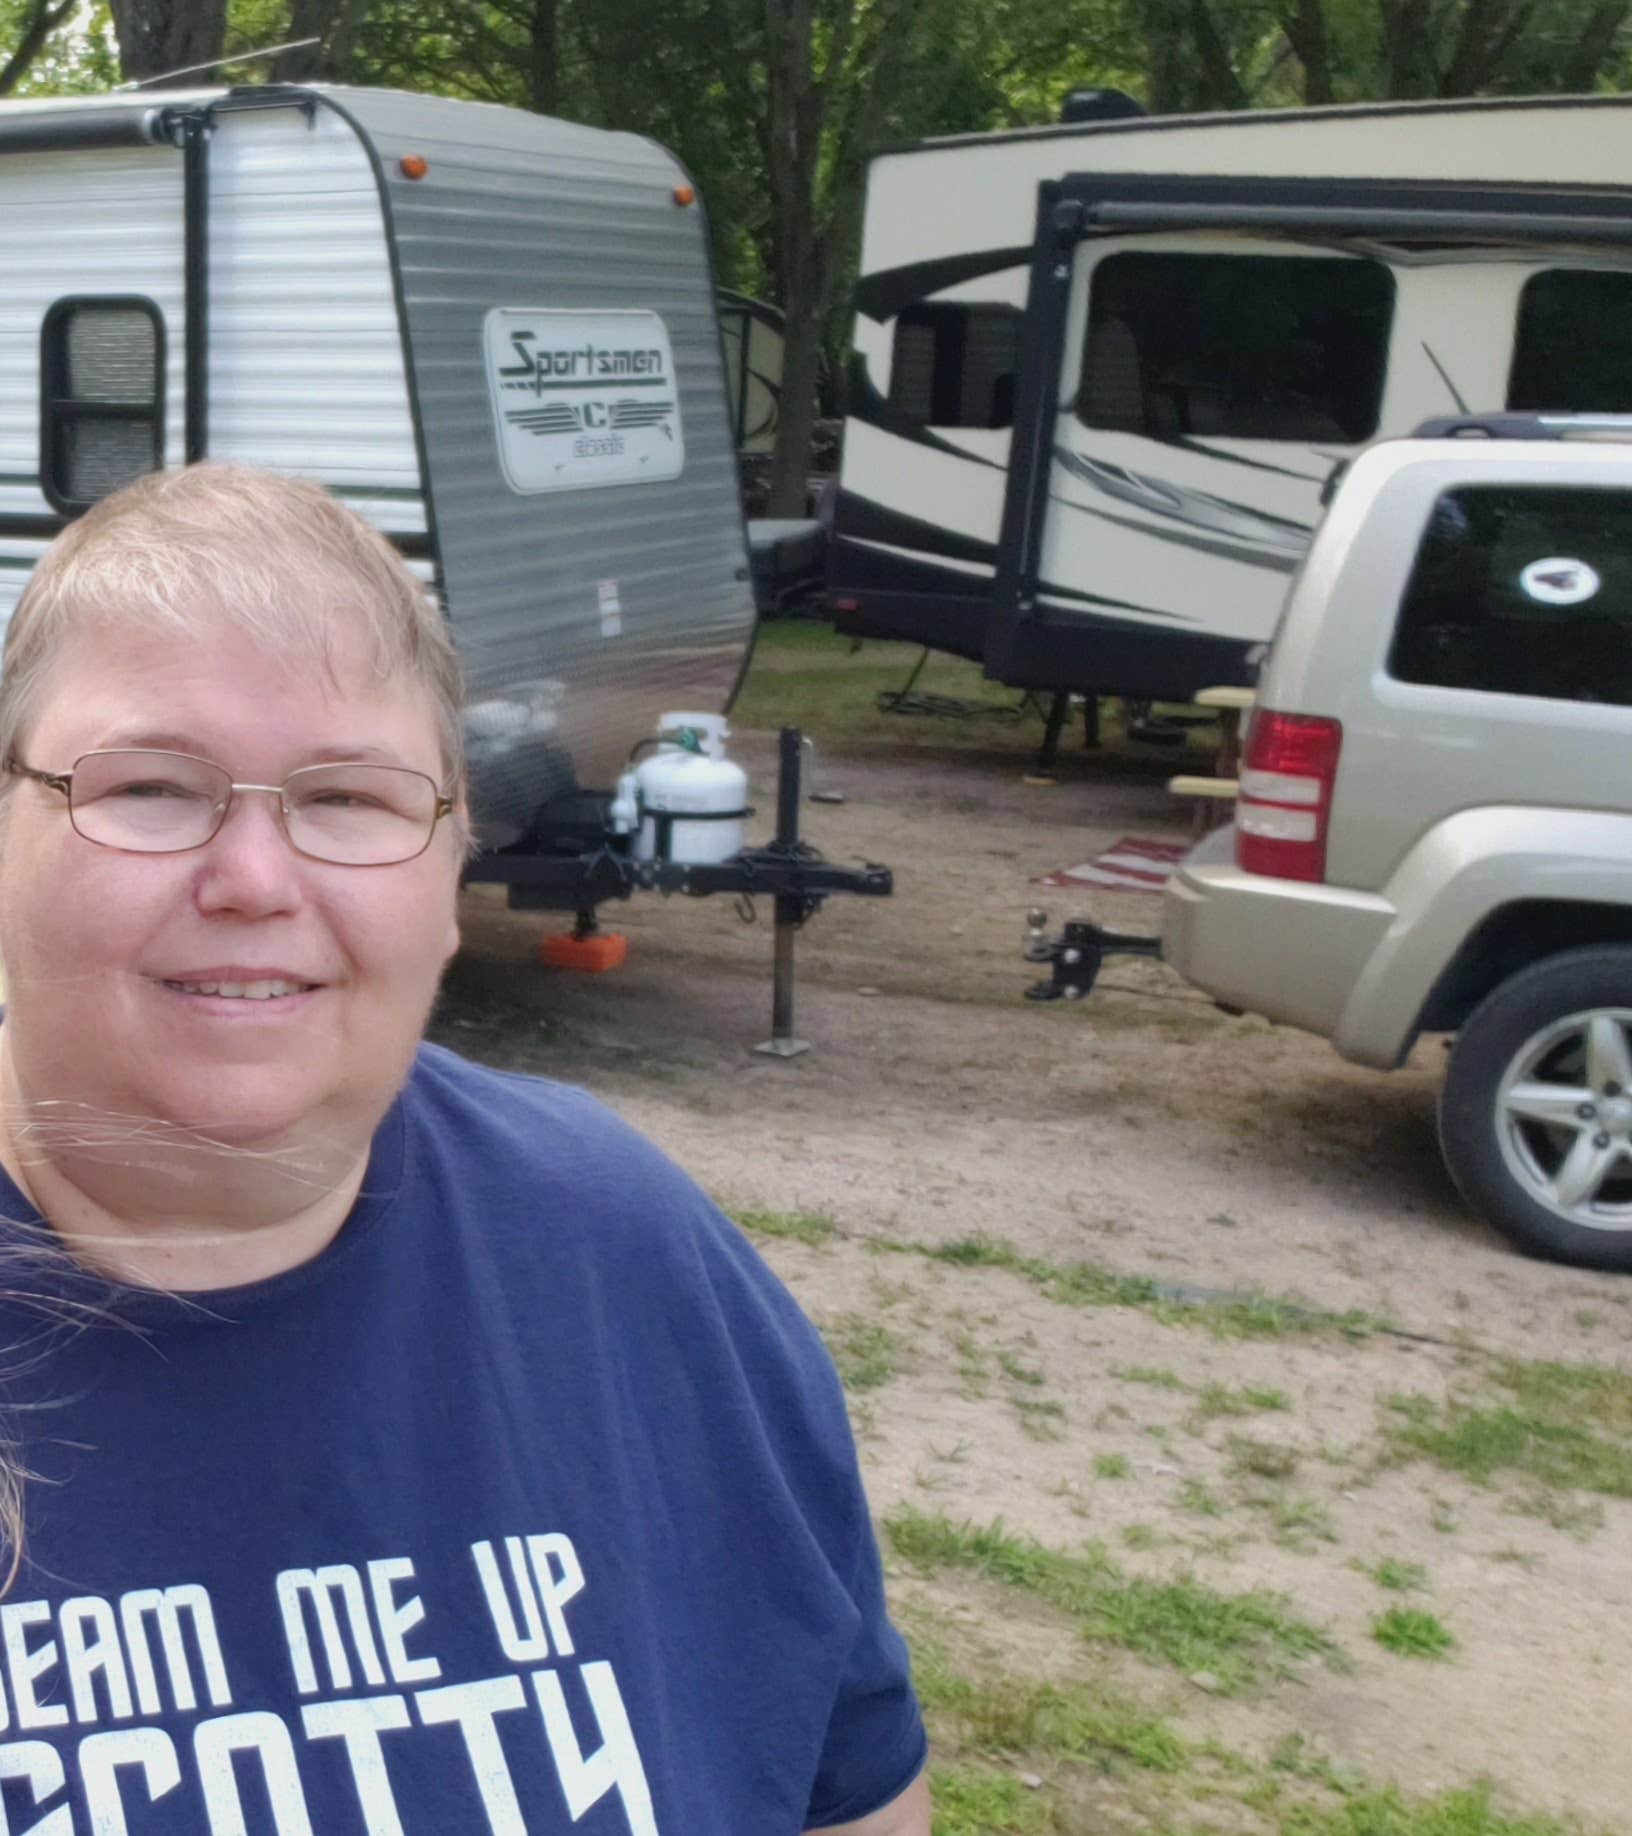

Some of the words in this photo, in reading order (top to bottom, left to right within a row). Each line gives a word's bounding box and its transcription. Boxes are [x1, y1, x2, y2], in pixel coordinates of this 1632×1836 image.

[499, 331, 663, 398] Sportsmen
[276, 1556, 442, 1693] ME
[471, 1532, 586, 1662] UP
